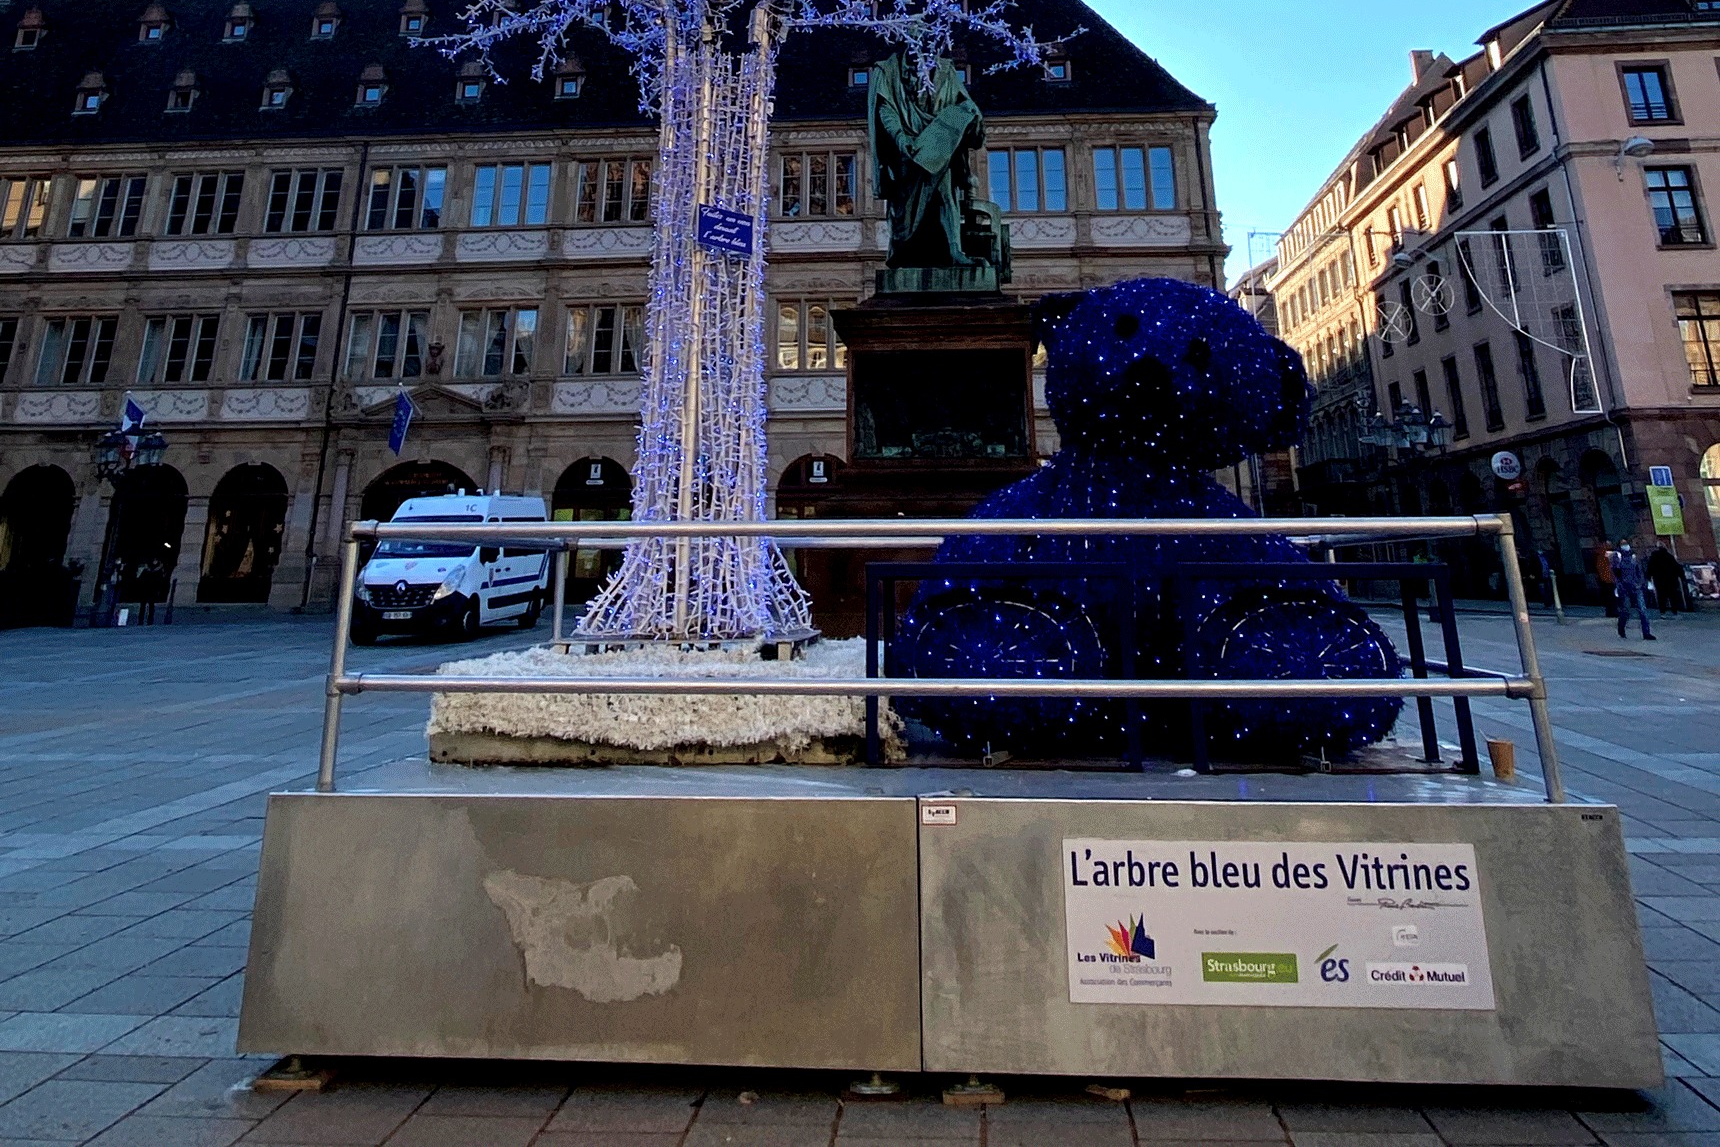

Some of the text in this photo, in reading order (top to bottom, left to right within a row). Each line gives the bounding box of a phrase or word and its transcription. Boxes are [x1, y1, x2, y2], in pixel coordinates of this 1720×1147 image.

[1071, 849, 1470, 891] L'arbre bleu des Vitrines
[1077, 952, 1141, 963] Les Vitrines
[1124, 963, 1172, 976] Strasbourg
[1371, 969, 1466, 982] Crédit Mutuel
